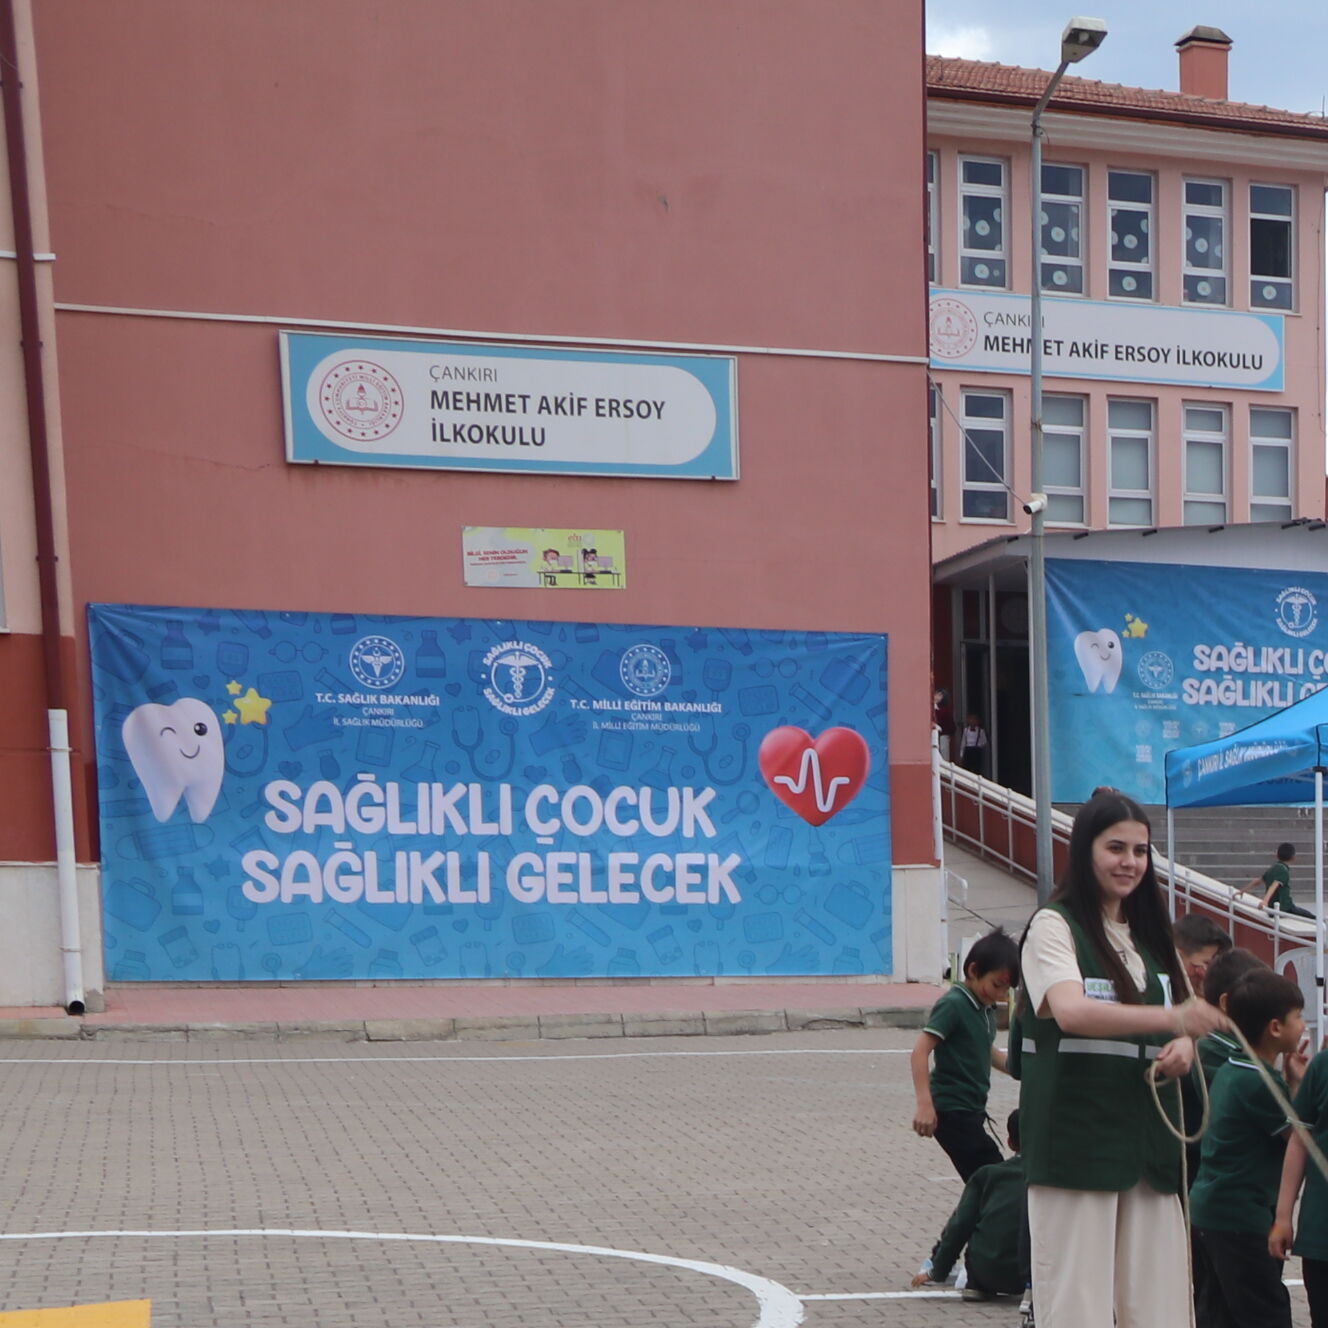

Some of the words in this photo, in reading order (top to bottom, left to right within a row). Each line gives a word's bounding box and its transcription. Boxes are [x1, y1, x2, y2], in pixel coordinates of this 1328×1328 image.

[983, 311, 1045, 329] ÇANKII
[1069, 339, 1110, 360] AKİF
[1114, 345, 1172, 365] ERSOY
[1176, 345, 1264, 371] İLKOKULU
[429, 365, 499, 383] ÇANKIRI
[430, 390, 531, 415] MEHMET
[536, 391, 588, 417] AKİF
[594, 397, 666, 420] ERSOY
[430, 417, 547, 447] İLKOKULU
[482, 640, 523, 667] SAĞLIKLI
[523, 642, 553, 669] ÇOCUK
[1193, 642, 1304, 675] SAĞLIKLI
[315, 692, 336, 704] T.C.
[337, 691, 378, 705] SAĞLIK
[380, 693, 440, 706] BAKANLIĞI
[483, 687, 522, 716] SAĞLIKLI
[522, 687, 556, 716] GELECEK
[570, 699, 590, 710] T.C.
[624, 698, 662, 712] EĞİTİM
[664, 700, 722, 713] BAKANLIĞI
[1182, 674, 1294, 708] SAĞLIKLI
[263, 772, 514, 837] SAĞLIKLI
[523, 783, 718, 845] ÇOCUK
[240, 841, 491, 905] SAĞLIKLI
[505, 850, 743, 906] GELECEK
